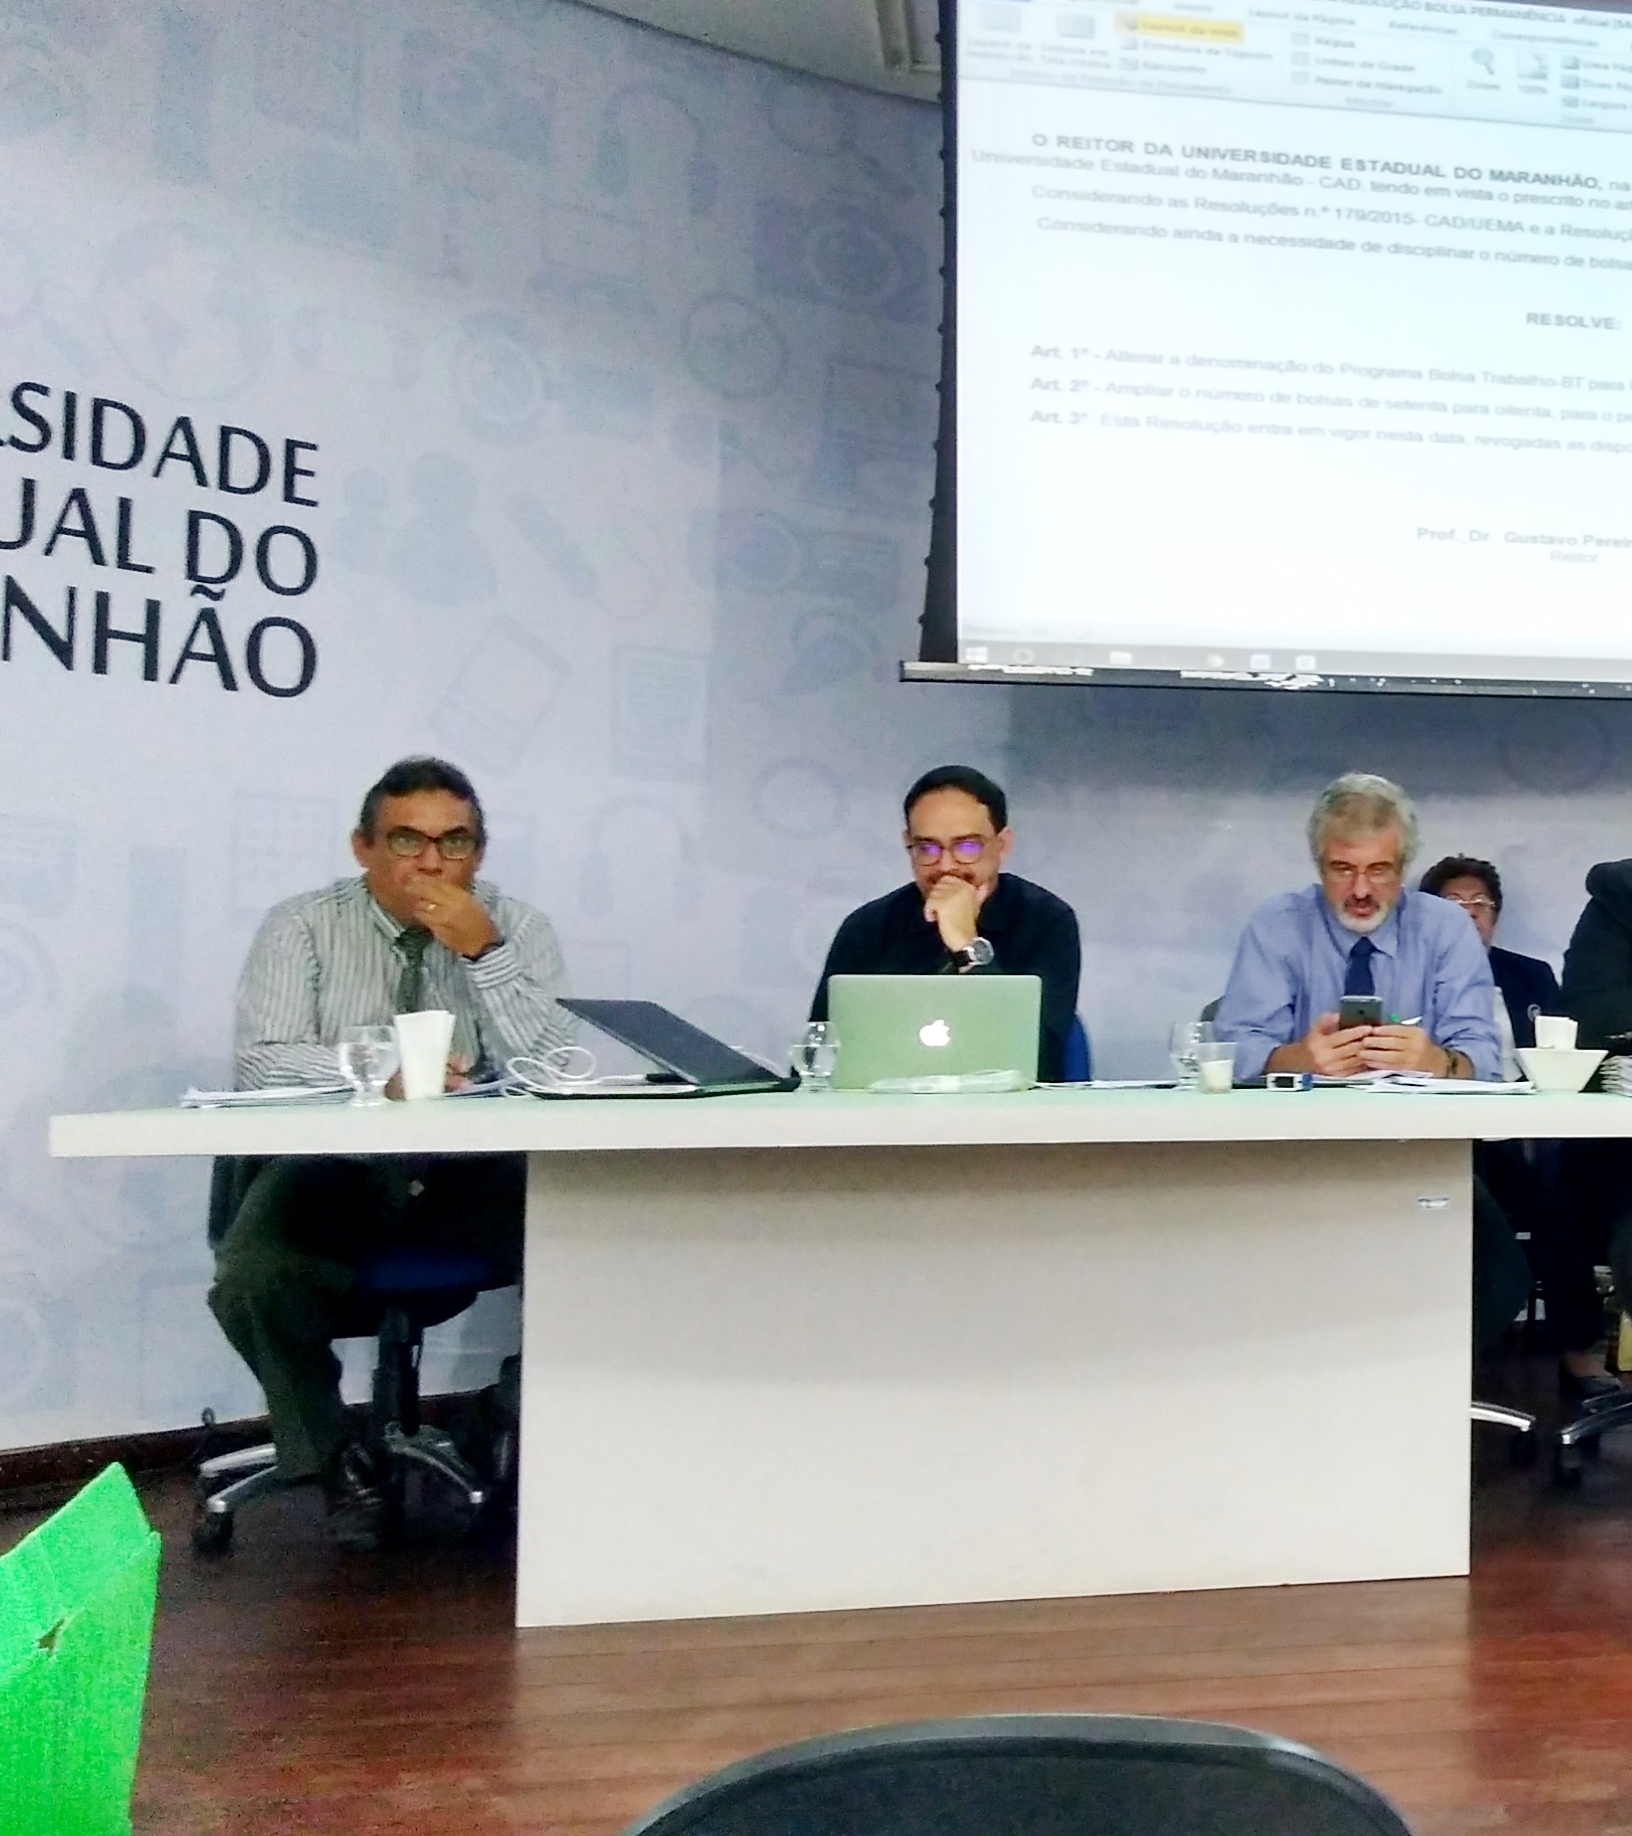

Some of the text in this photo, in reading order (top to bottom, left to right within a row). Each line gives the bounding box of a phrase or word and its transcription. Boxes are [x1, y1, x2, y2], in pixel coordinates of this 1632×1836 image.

[1032, 134, 1048, 147] O
[1056, 136, 1134, 153] REITOR
[1144, 143, 1173, 156] DA
[1181, 146, 1331, 169] UNIVERSIDADE
[1341, 158, 1446, 177] ESTADUAL
[1454, 167, 1483, 180] DO
[1101, 160, 1179, 177] Estadual
[1185, 166, 1206, 179] do
[1212, 168, 1303, 187] Maranhão
[1371, 182, 1419, 196] tendo
[1425, 188, 1450, 198] em
[1455, 188, 1493, 202] vista
[1031, 186, 1163, 207] Considerando
[1168, 199, 1188, 209] as
[1194, 198, 1299, 217] Resoluções
[1037, 217, 1168, 240] Considerando
[1173, 230, 1222, 243] ainda
[1244, 234, 1356, 251] necessidade
[1361, 240, 1382, 253] de
[1564, 255, 1584, 268] de
[1185, 354, 1308, 374] denominação
[0, 381, 319, 507] SIDADE
[185, 509, 318, 597] DO
[2, 574, 318, 698] NHÃO
